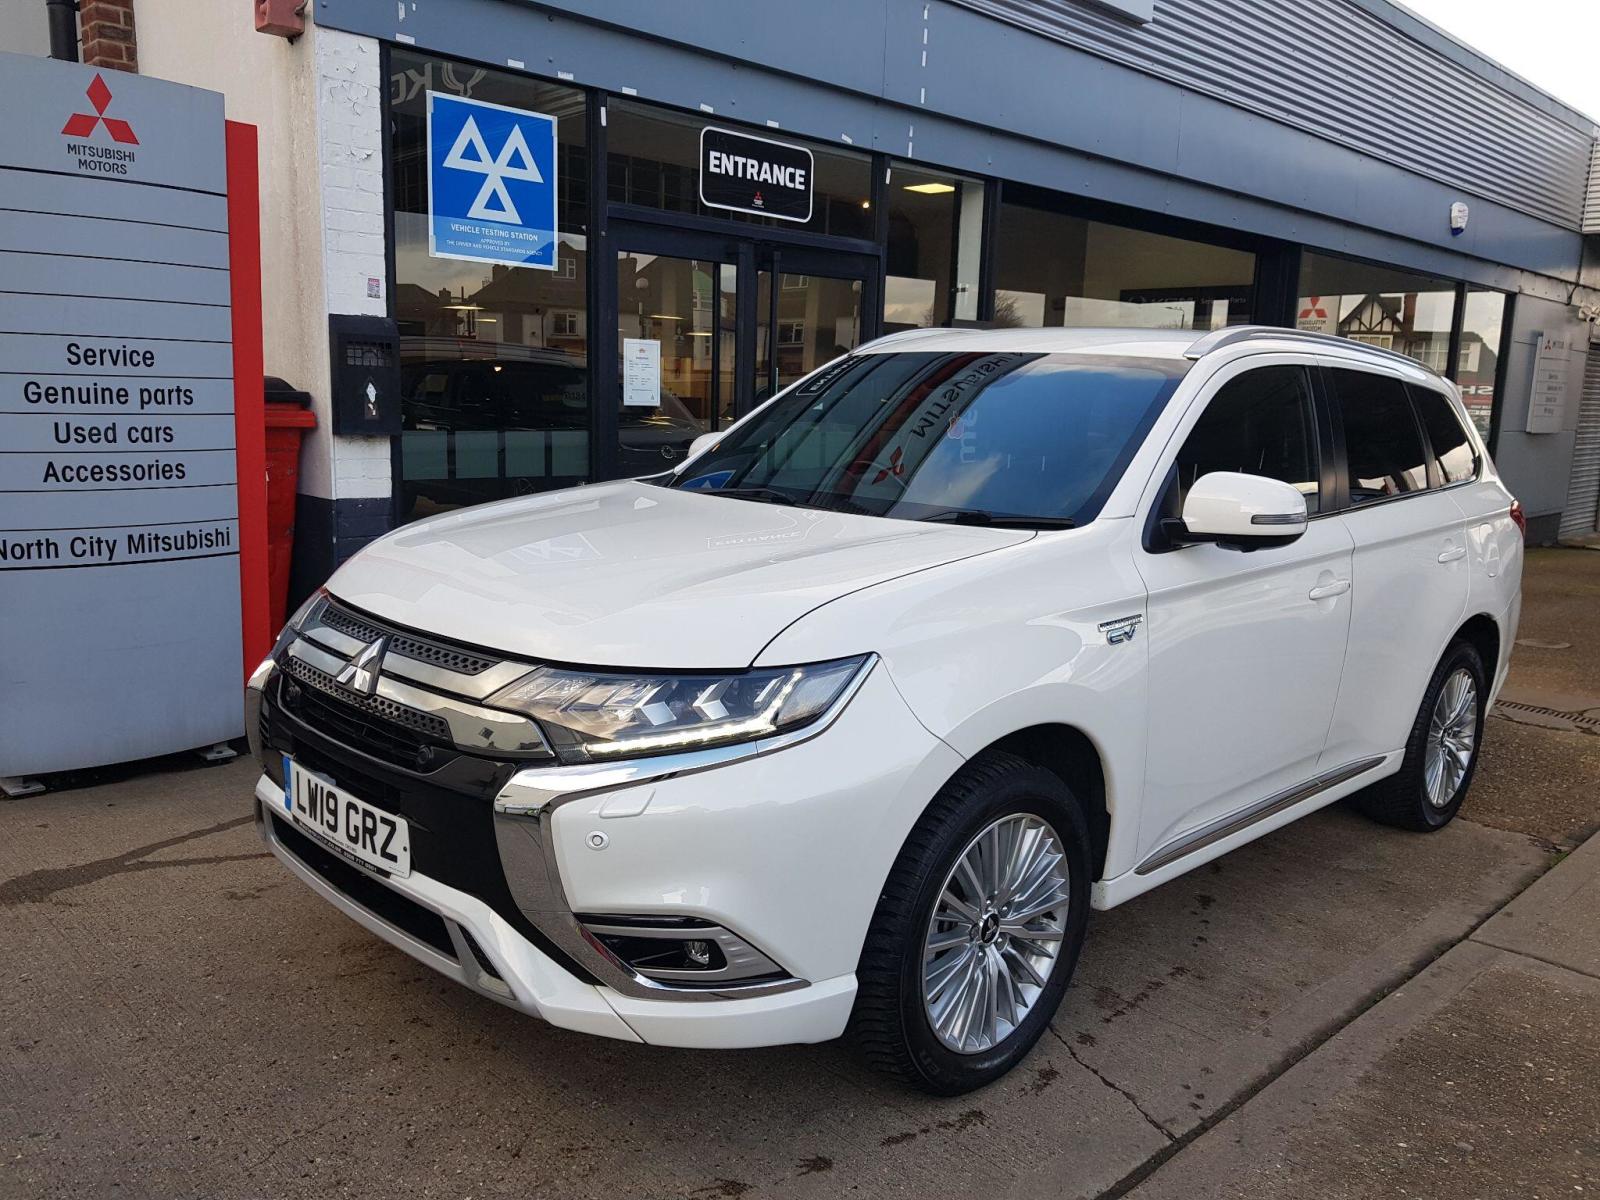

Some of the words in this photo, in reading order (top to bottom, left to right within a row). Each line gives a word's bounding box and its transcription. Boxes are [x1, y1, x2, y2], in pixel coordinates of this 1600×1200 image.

[67, 143, 135, 163] MITSUBISHI
[78, 158, 127, 175] MOTORS
[709, 150, 805, 190] ENTRANCE
[451, 223, 480, 234] VEHICLE
[481, 227, 509, 238] TESTING
[510, 231, 538, 241] STATION
[66, 342, 155, 368] Service
[23, 381, 129, 405] Genuine
[139, 385, 194, 410] parts
[53, 421, 118, 444] Used
[127, 425, 174, 444] cars
[43, 459, 186, 483] Accessories
[70, 535, 118, 561] City
[127, 527, 231, 555] Mitsubishi
[296, 770, 338, 833] LW19
[345, 801, 398, 863] GRZ
